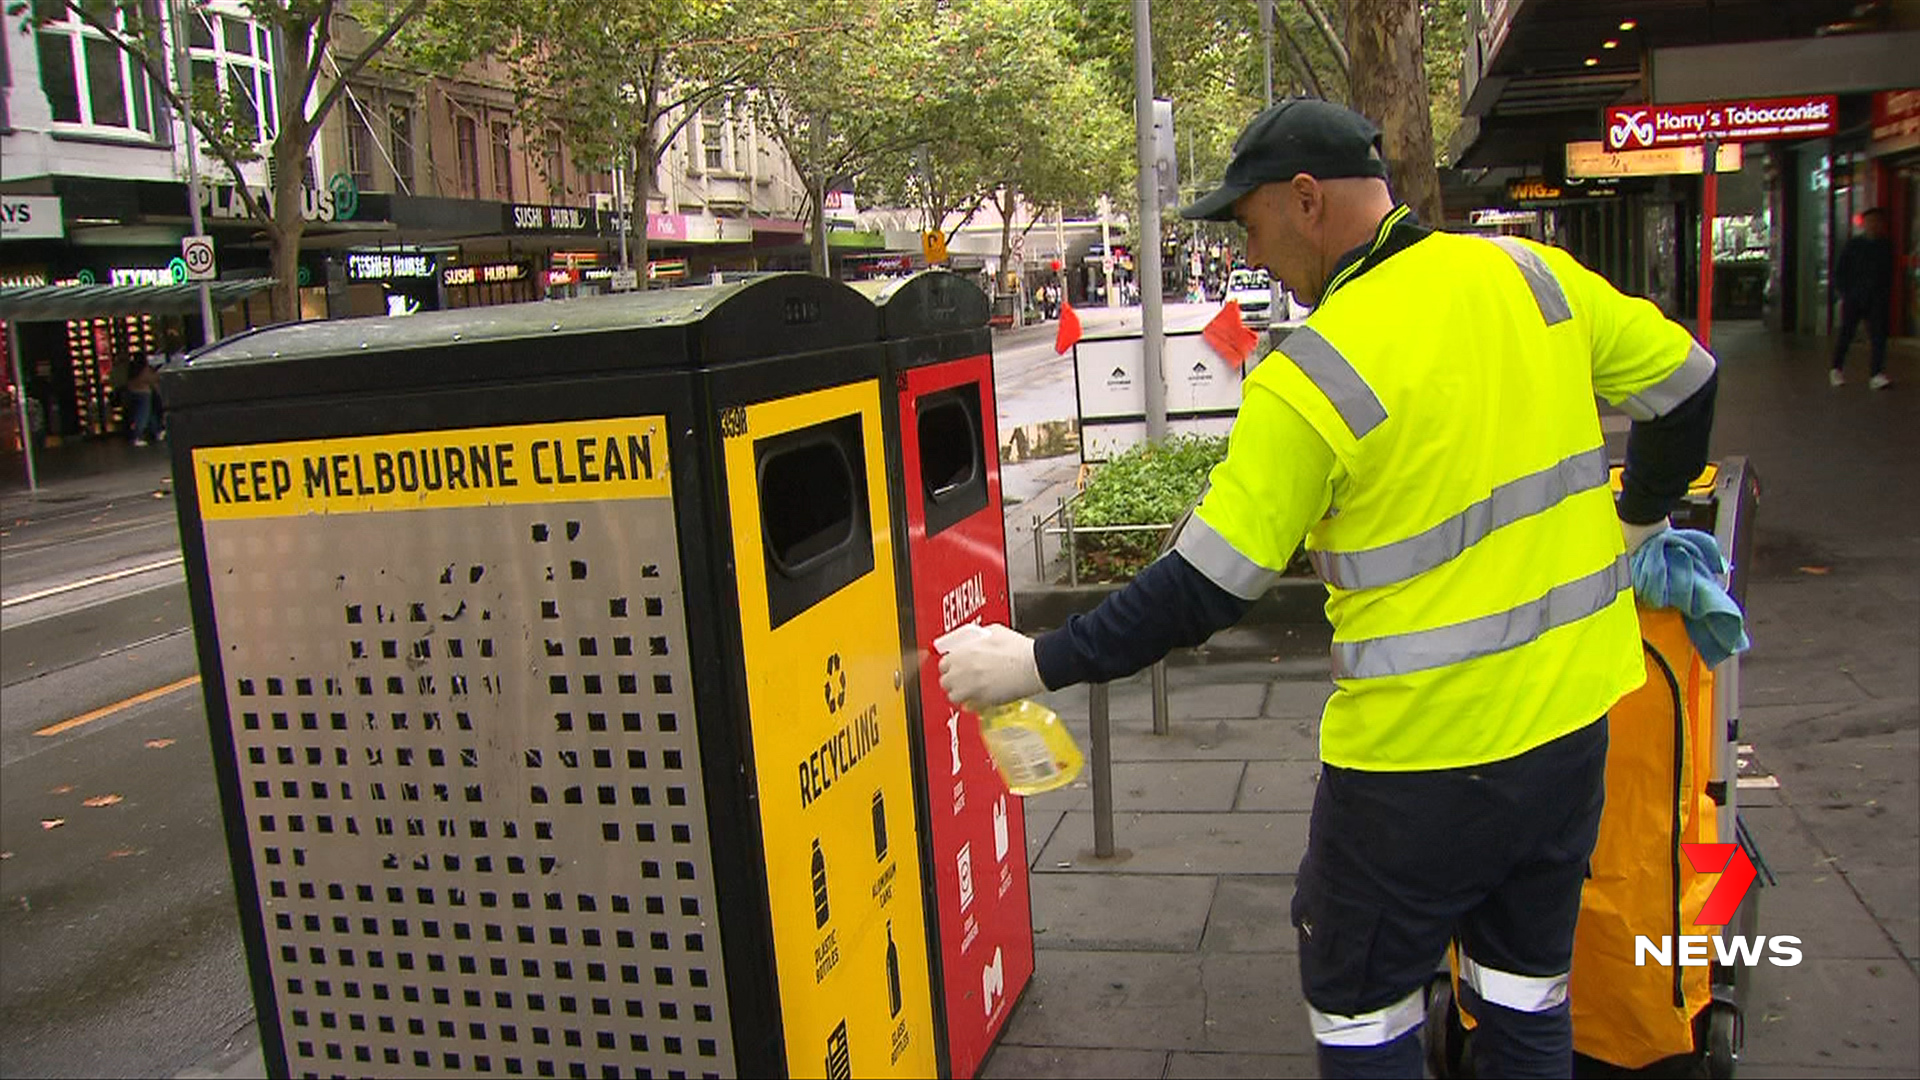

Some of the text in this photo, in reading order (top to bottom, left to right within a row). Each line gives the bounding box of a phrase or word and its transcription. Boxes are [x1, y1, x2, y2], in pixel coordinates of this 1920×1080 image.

[1656, 102, 1829, 131] Harry's Tobacconist
[514, 206, 543, 229] SUSHI
[190, 250, 209, 265] 30
[444, 268, 475, 285] SUSHI
[209, 434, 655, 505] KEEP MELBOURNE CLEAN
[942, 571, 986, 630] GENERAL
[799, 703, 880, 810] RECYCLING
